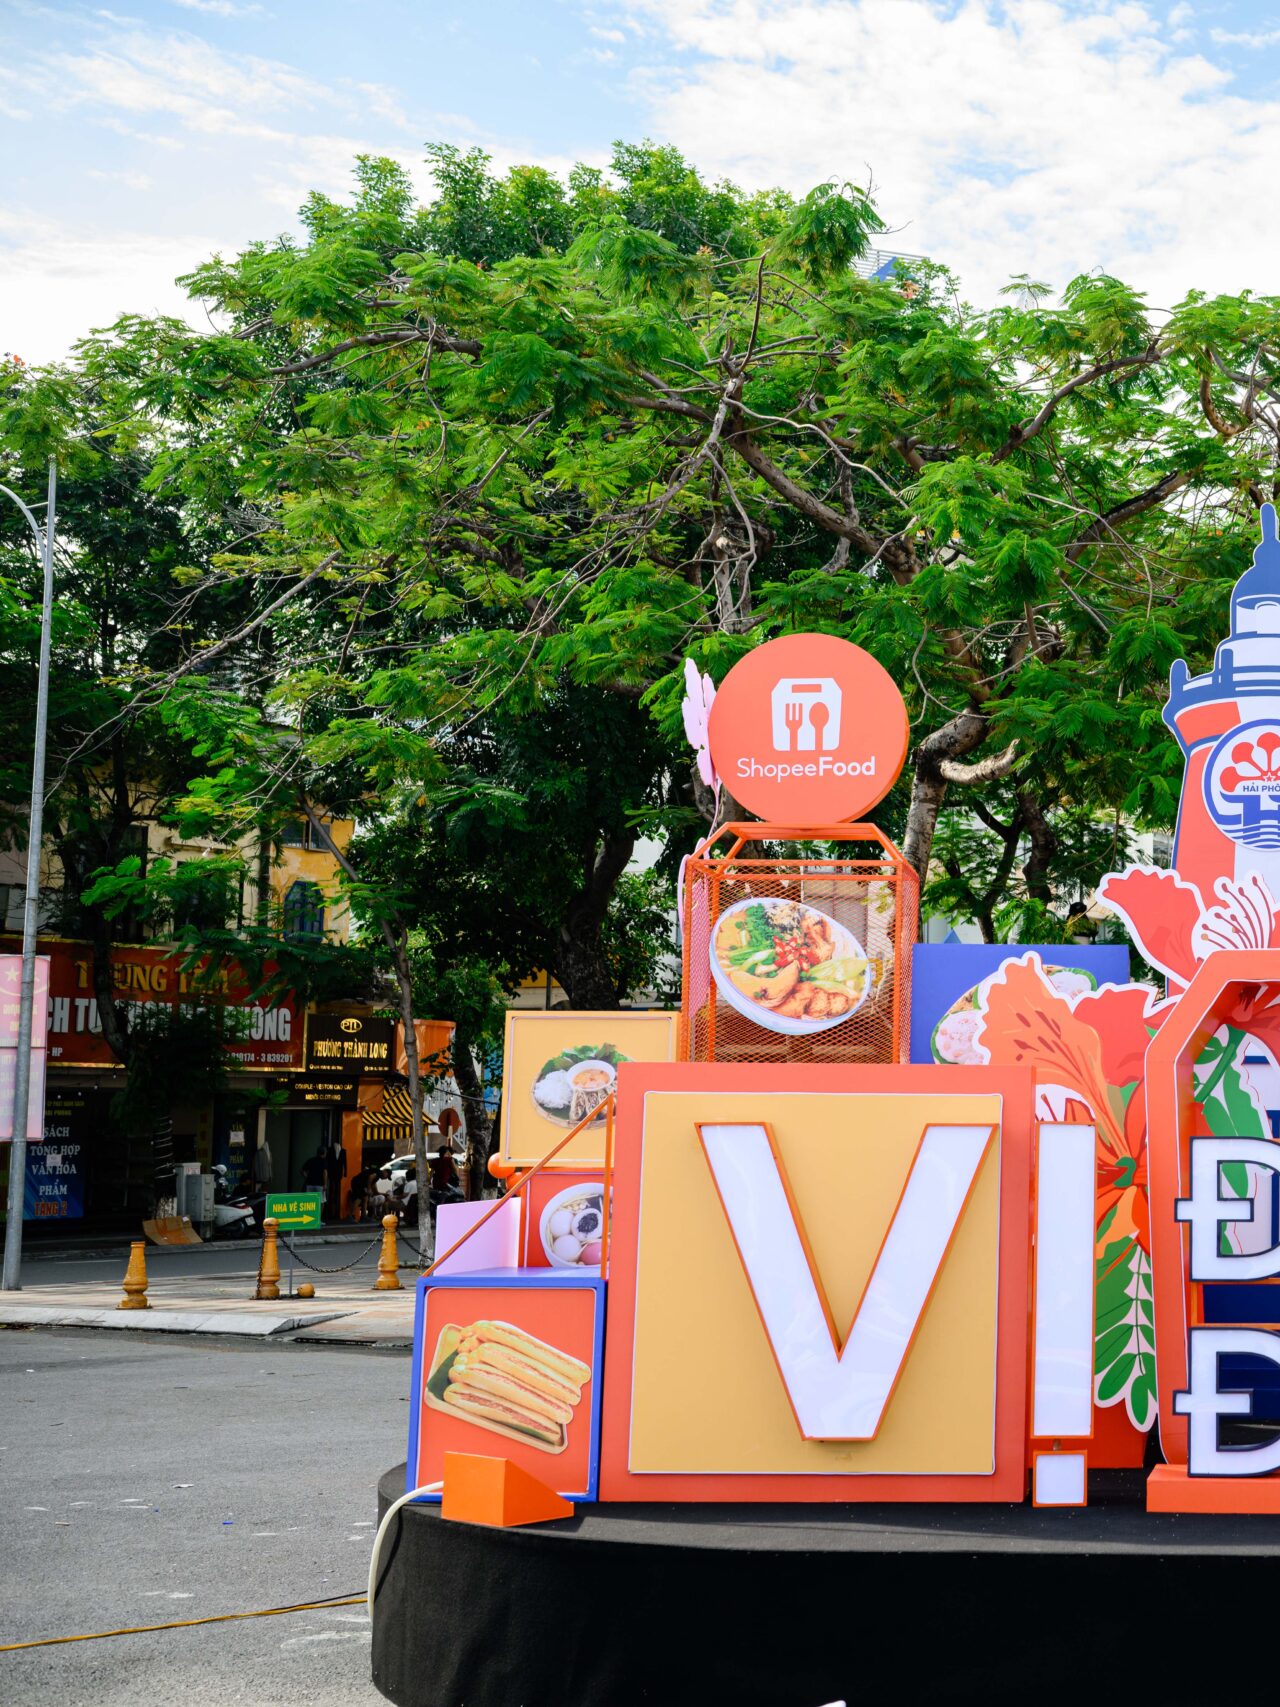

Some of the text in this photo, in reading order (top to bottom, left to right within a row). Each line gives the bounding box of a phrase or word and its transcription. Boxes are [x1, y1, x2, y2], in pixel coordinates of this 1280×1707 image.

[736, 756, 876, 783] ShopeeFood
[74, 960, 167, 992] TUNG
[344, 1038, 368, 1058] THÀNH
[369, 1043, 388, 1058] LONG
[272, 1200, 316, 1213] NHÀ VỆ SINH
